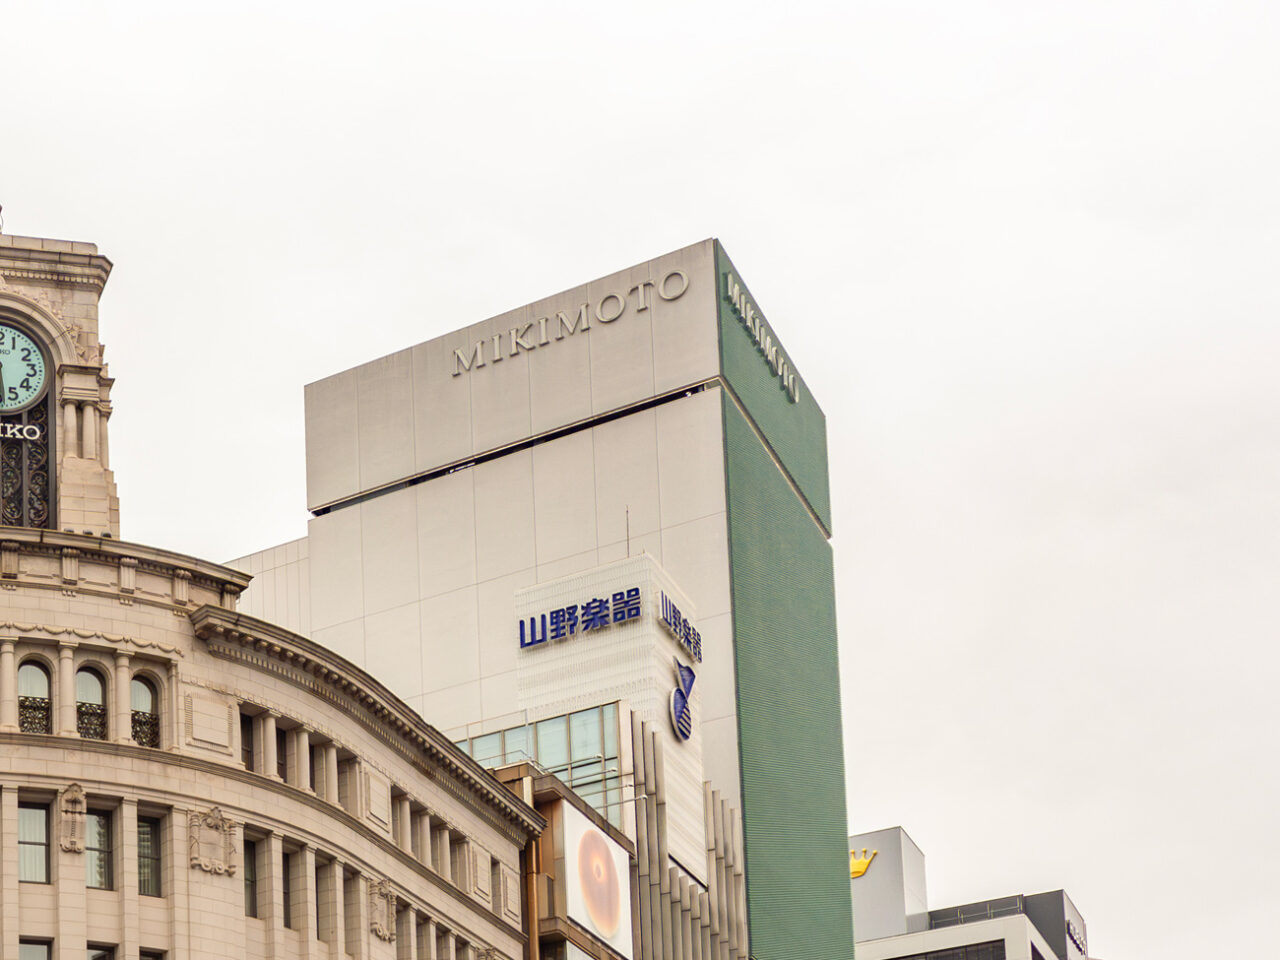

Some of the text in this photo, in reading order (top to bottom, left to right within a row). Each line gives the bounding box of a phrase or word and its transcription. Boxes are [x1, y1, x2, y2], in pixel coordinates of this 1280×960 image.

[451, 270, 690, 378] MIKIMOTO
[11, 336, 16, 350] 1
[20, 348, 32, 362] 2
[26, 363, 37, 377] 3
[20, 378, 32, 391] 4
[7, 387, 19, 401] 5
[519, 587, 641, 649] 山野楽器
[661, 590, 702, 664] 山野楽器
